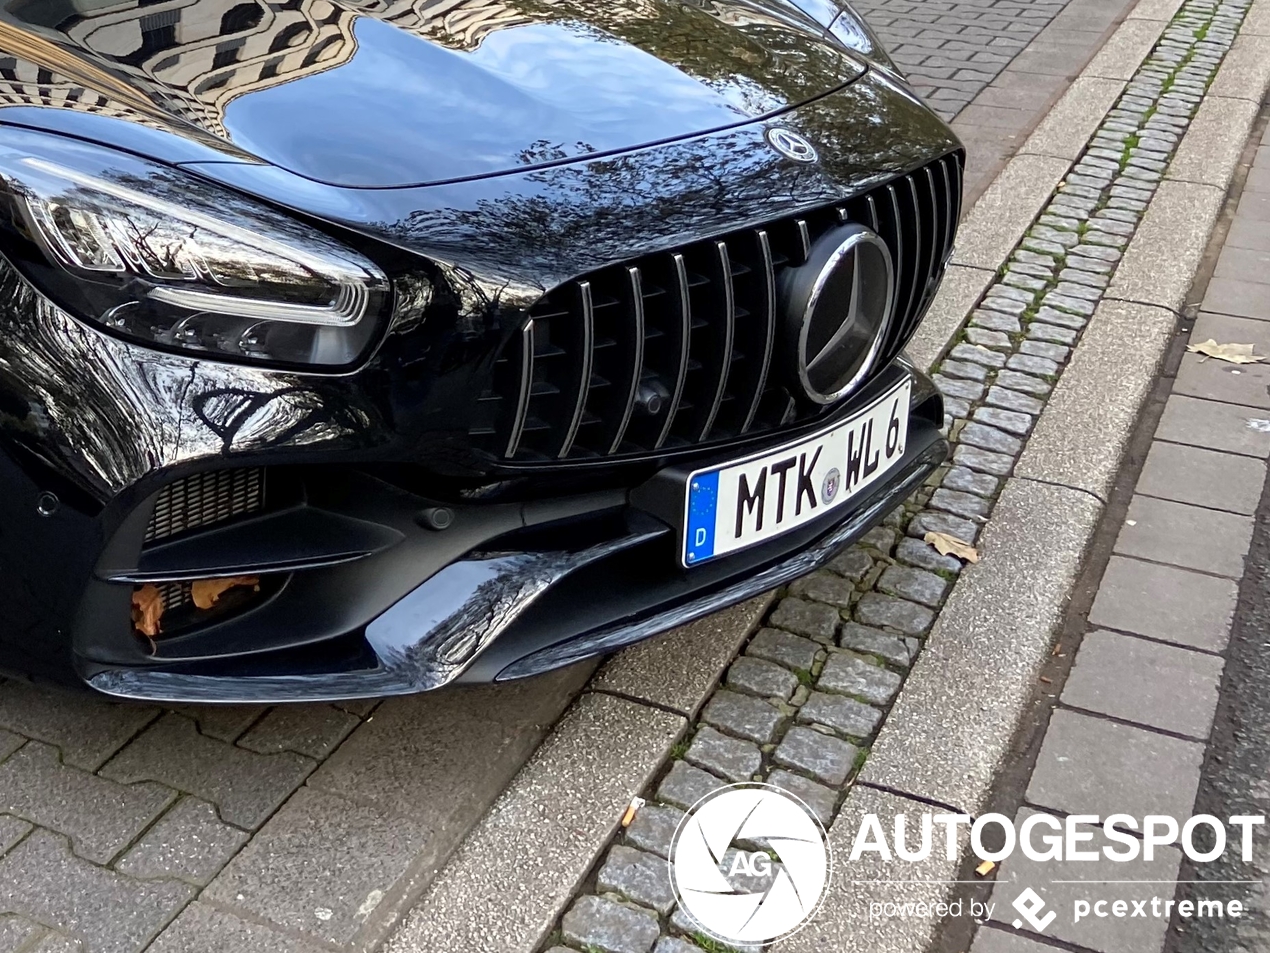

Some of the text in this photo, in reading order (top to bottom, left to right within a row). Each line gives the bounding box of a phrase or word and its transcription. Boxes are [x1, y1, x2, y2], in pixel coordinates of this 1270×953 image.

[734, 398, 900, 539] MTK WL 6
[695, 527, 707, 547] D
